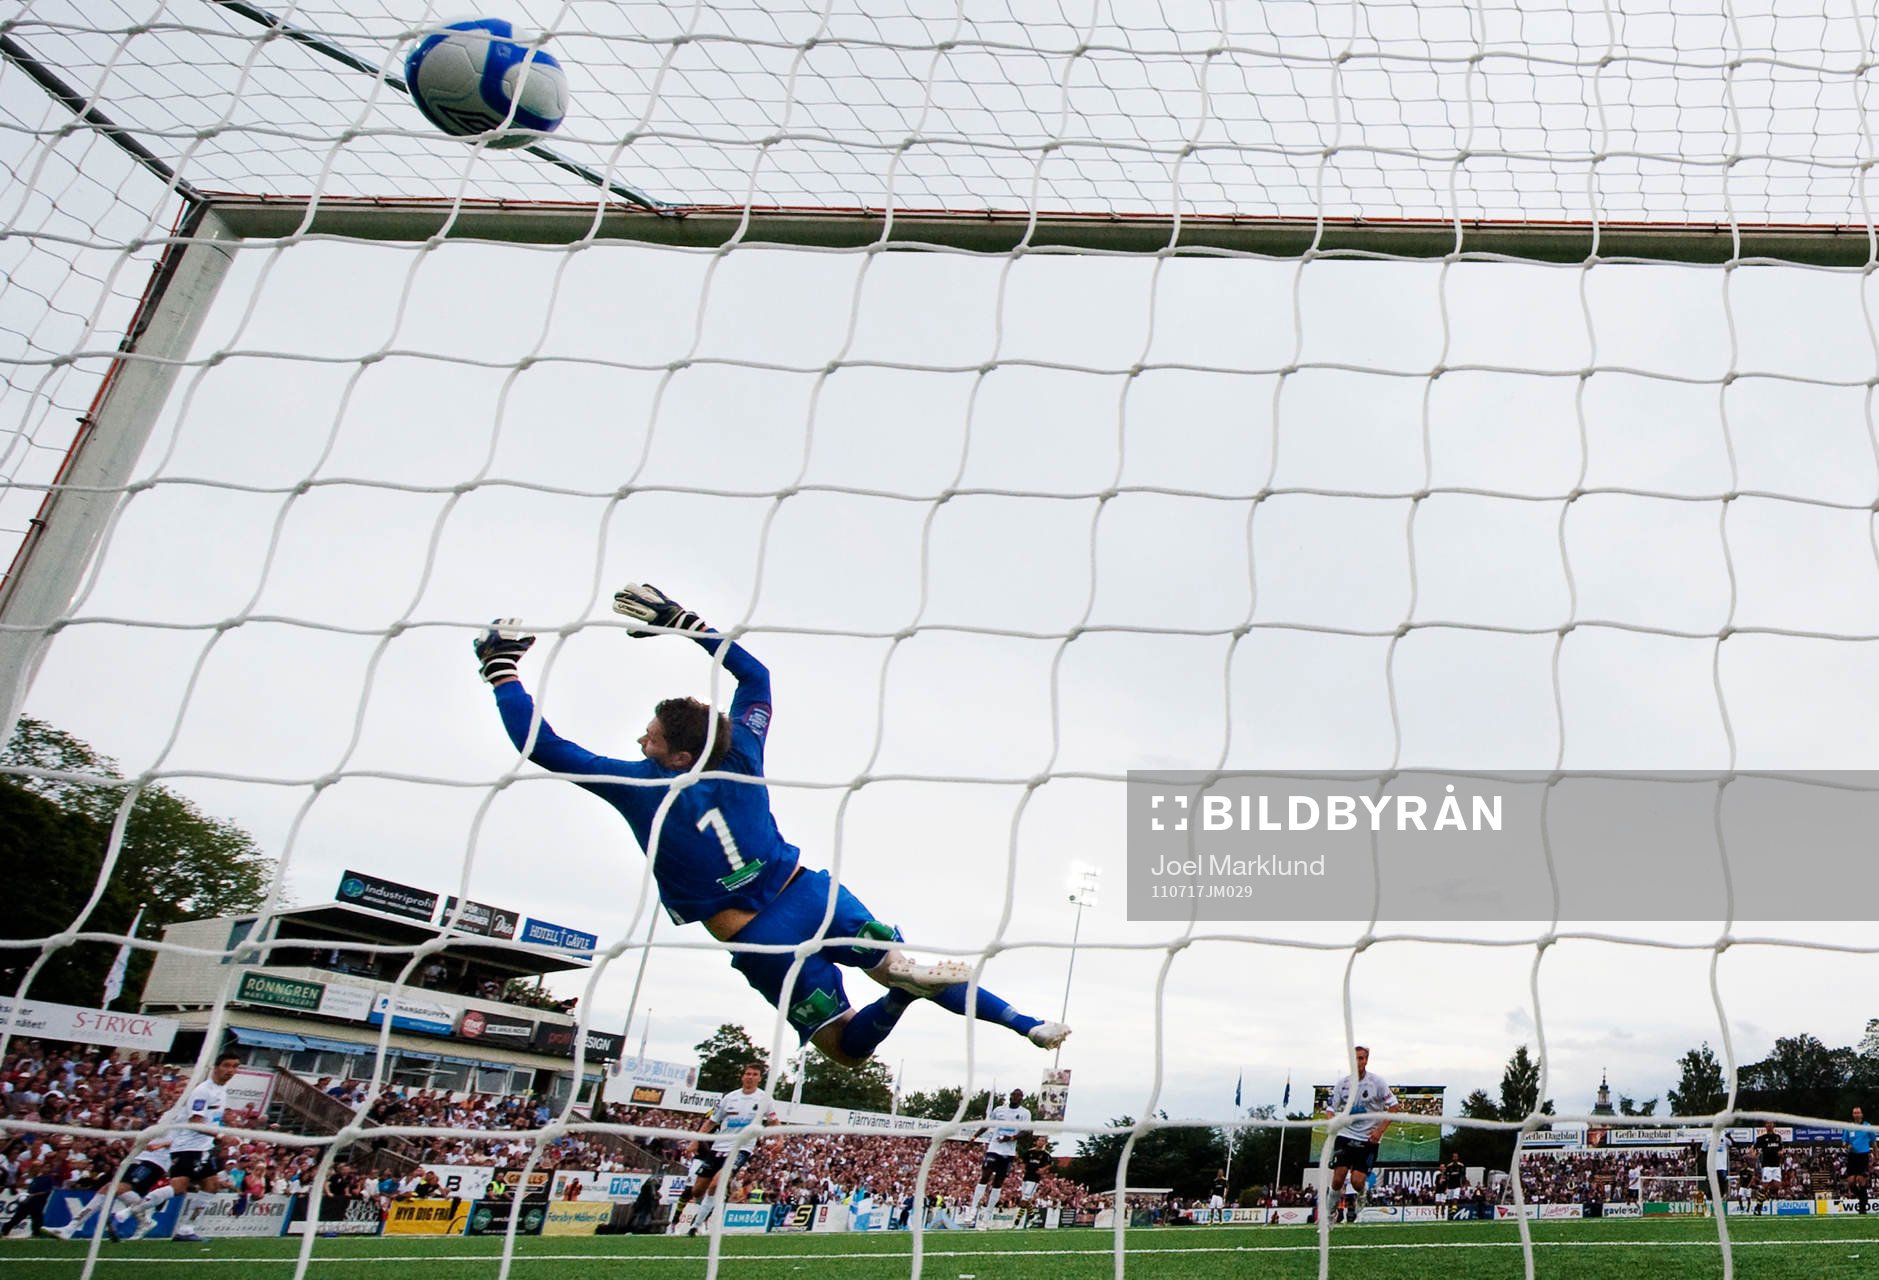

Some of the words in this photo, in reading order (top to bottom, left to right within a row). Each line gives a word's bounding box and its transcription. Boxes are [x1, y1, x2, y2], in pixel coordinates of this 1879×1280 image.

[696, 807, 746, 872] 1
[365, 884, 435, 909] Industriprofil
[529, 924, 559, 943] HOTELL
[565, 933, 591, 950] GÄVLE
[246, 978, 320, 1000] RÖNNGREN
[72, 1011, 158, 1037] S-TRYCK
[1544, 1130, 1578, 1142] Dagblad
[1615, 1130, 1638, 1139] Gefle
[1639, 1130, 1671, 1141] Dagblad
[1233, 1209, 1262, 1221] ELIT
[1405, 1208, 1446, 1217] S-TRYC
